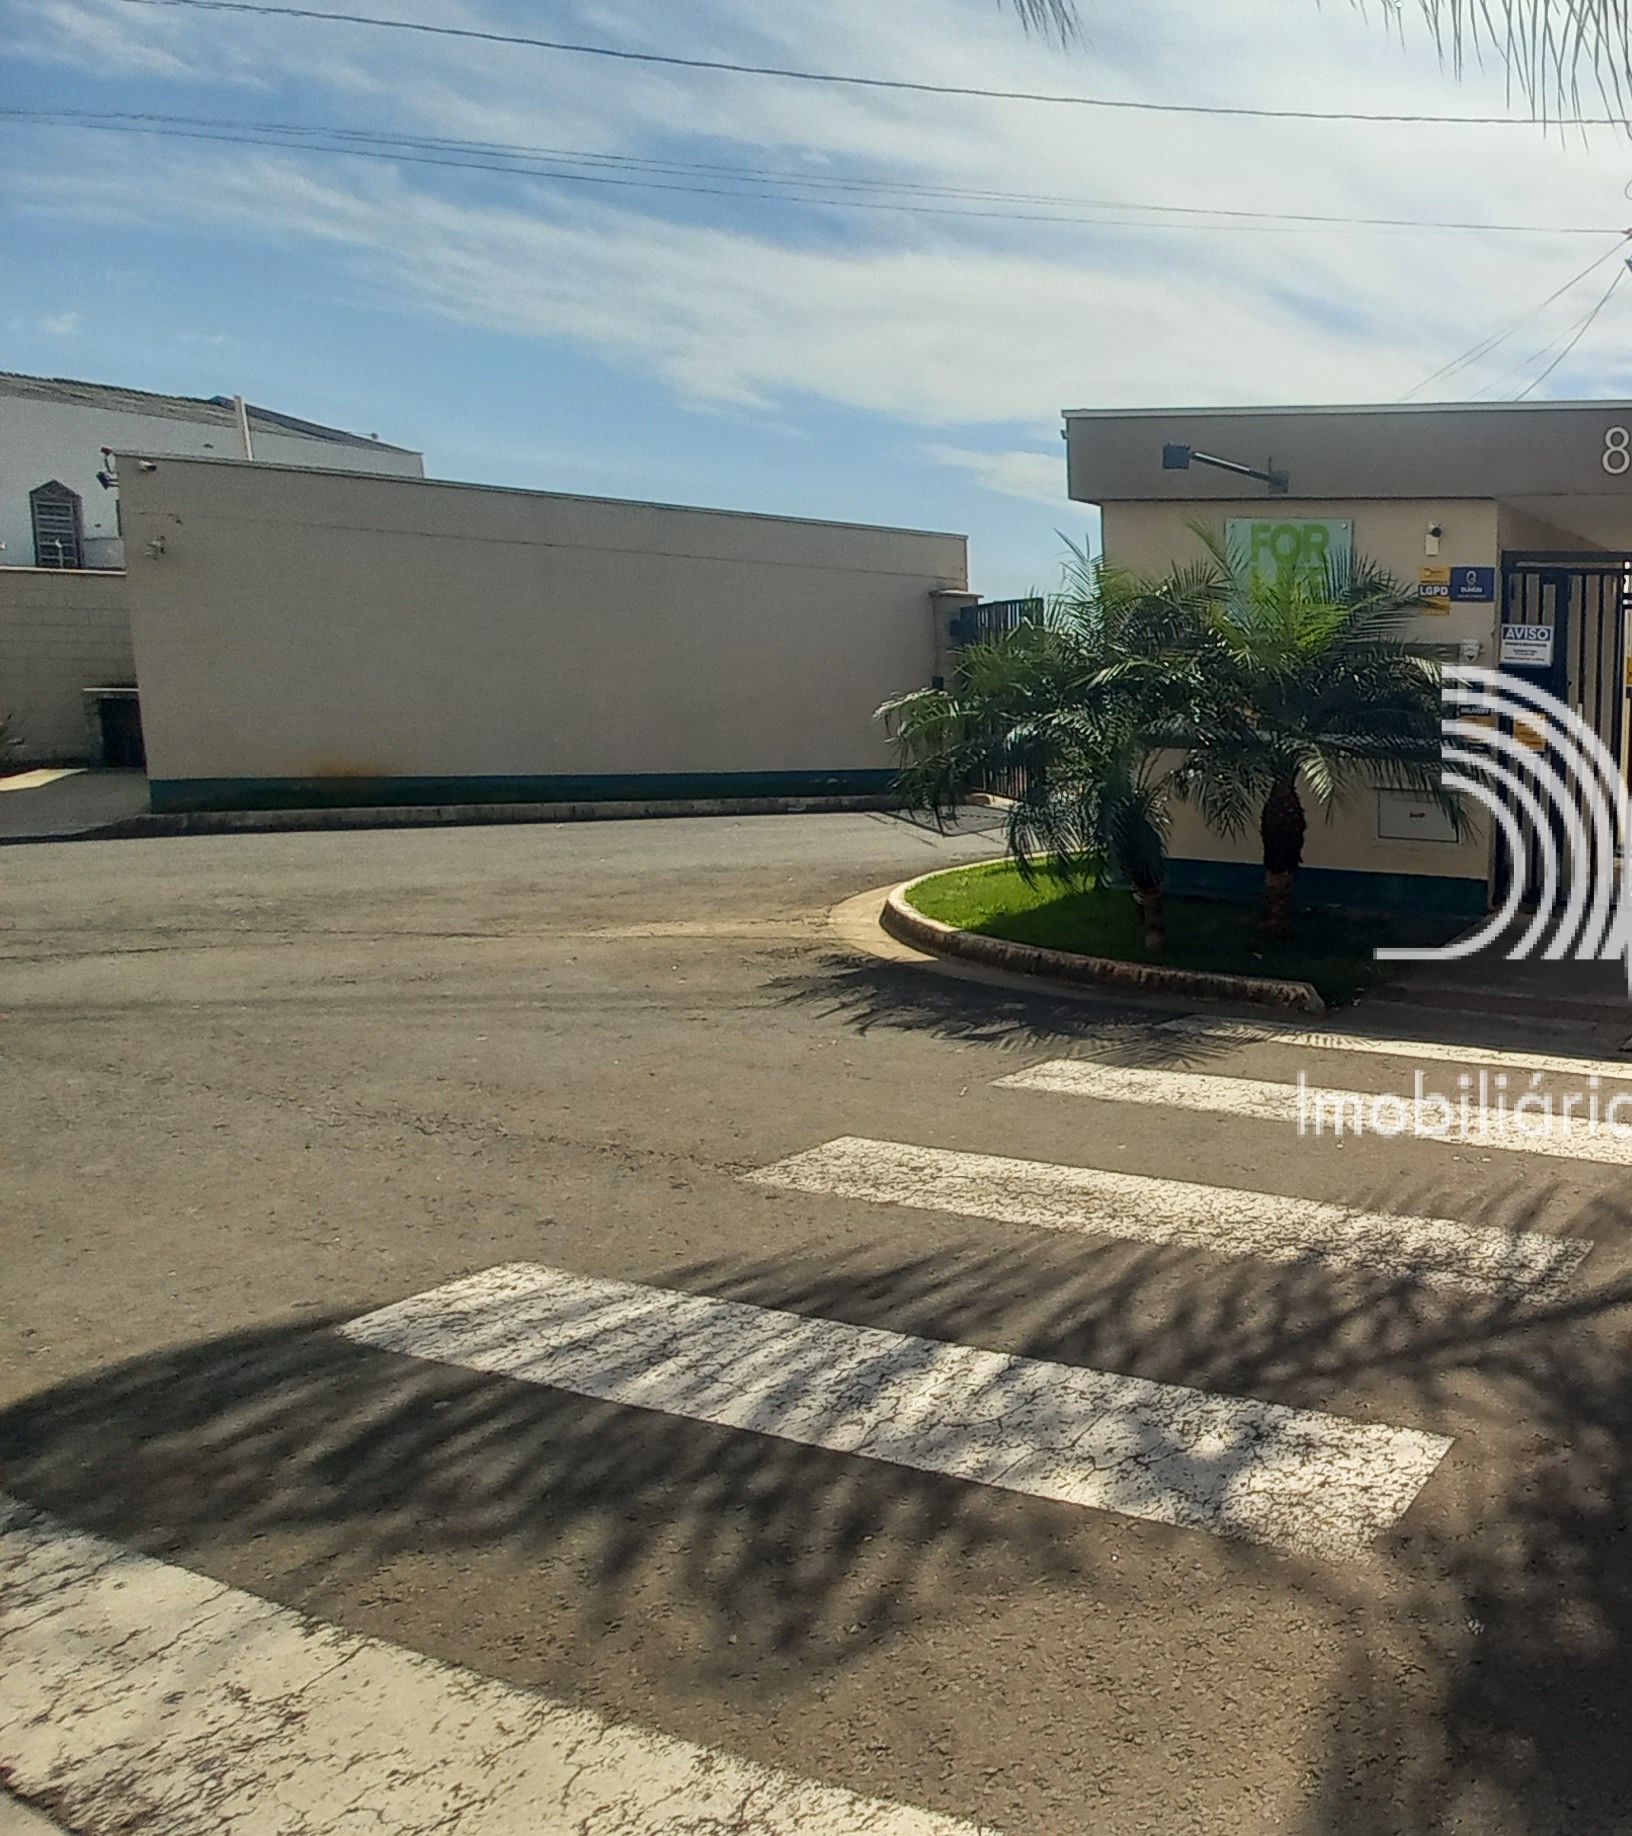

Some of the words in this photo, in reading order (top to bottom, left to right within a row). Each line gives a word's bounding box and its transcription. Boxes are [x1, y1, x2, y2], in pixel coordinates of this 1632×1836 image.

[1251, 523, 1330, 565] FOR
[1420, 586, 1449, 596] LGPD
[1505, 627, 1549, 640] AVISO
